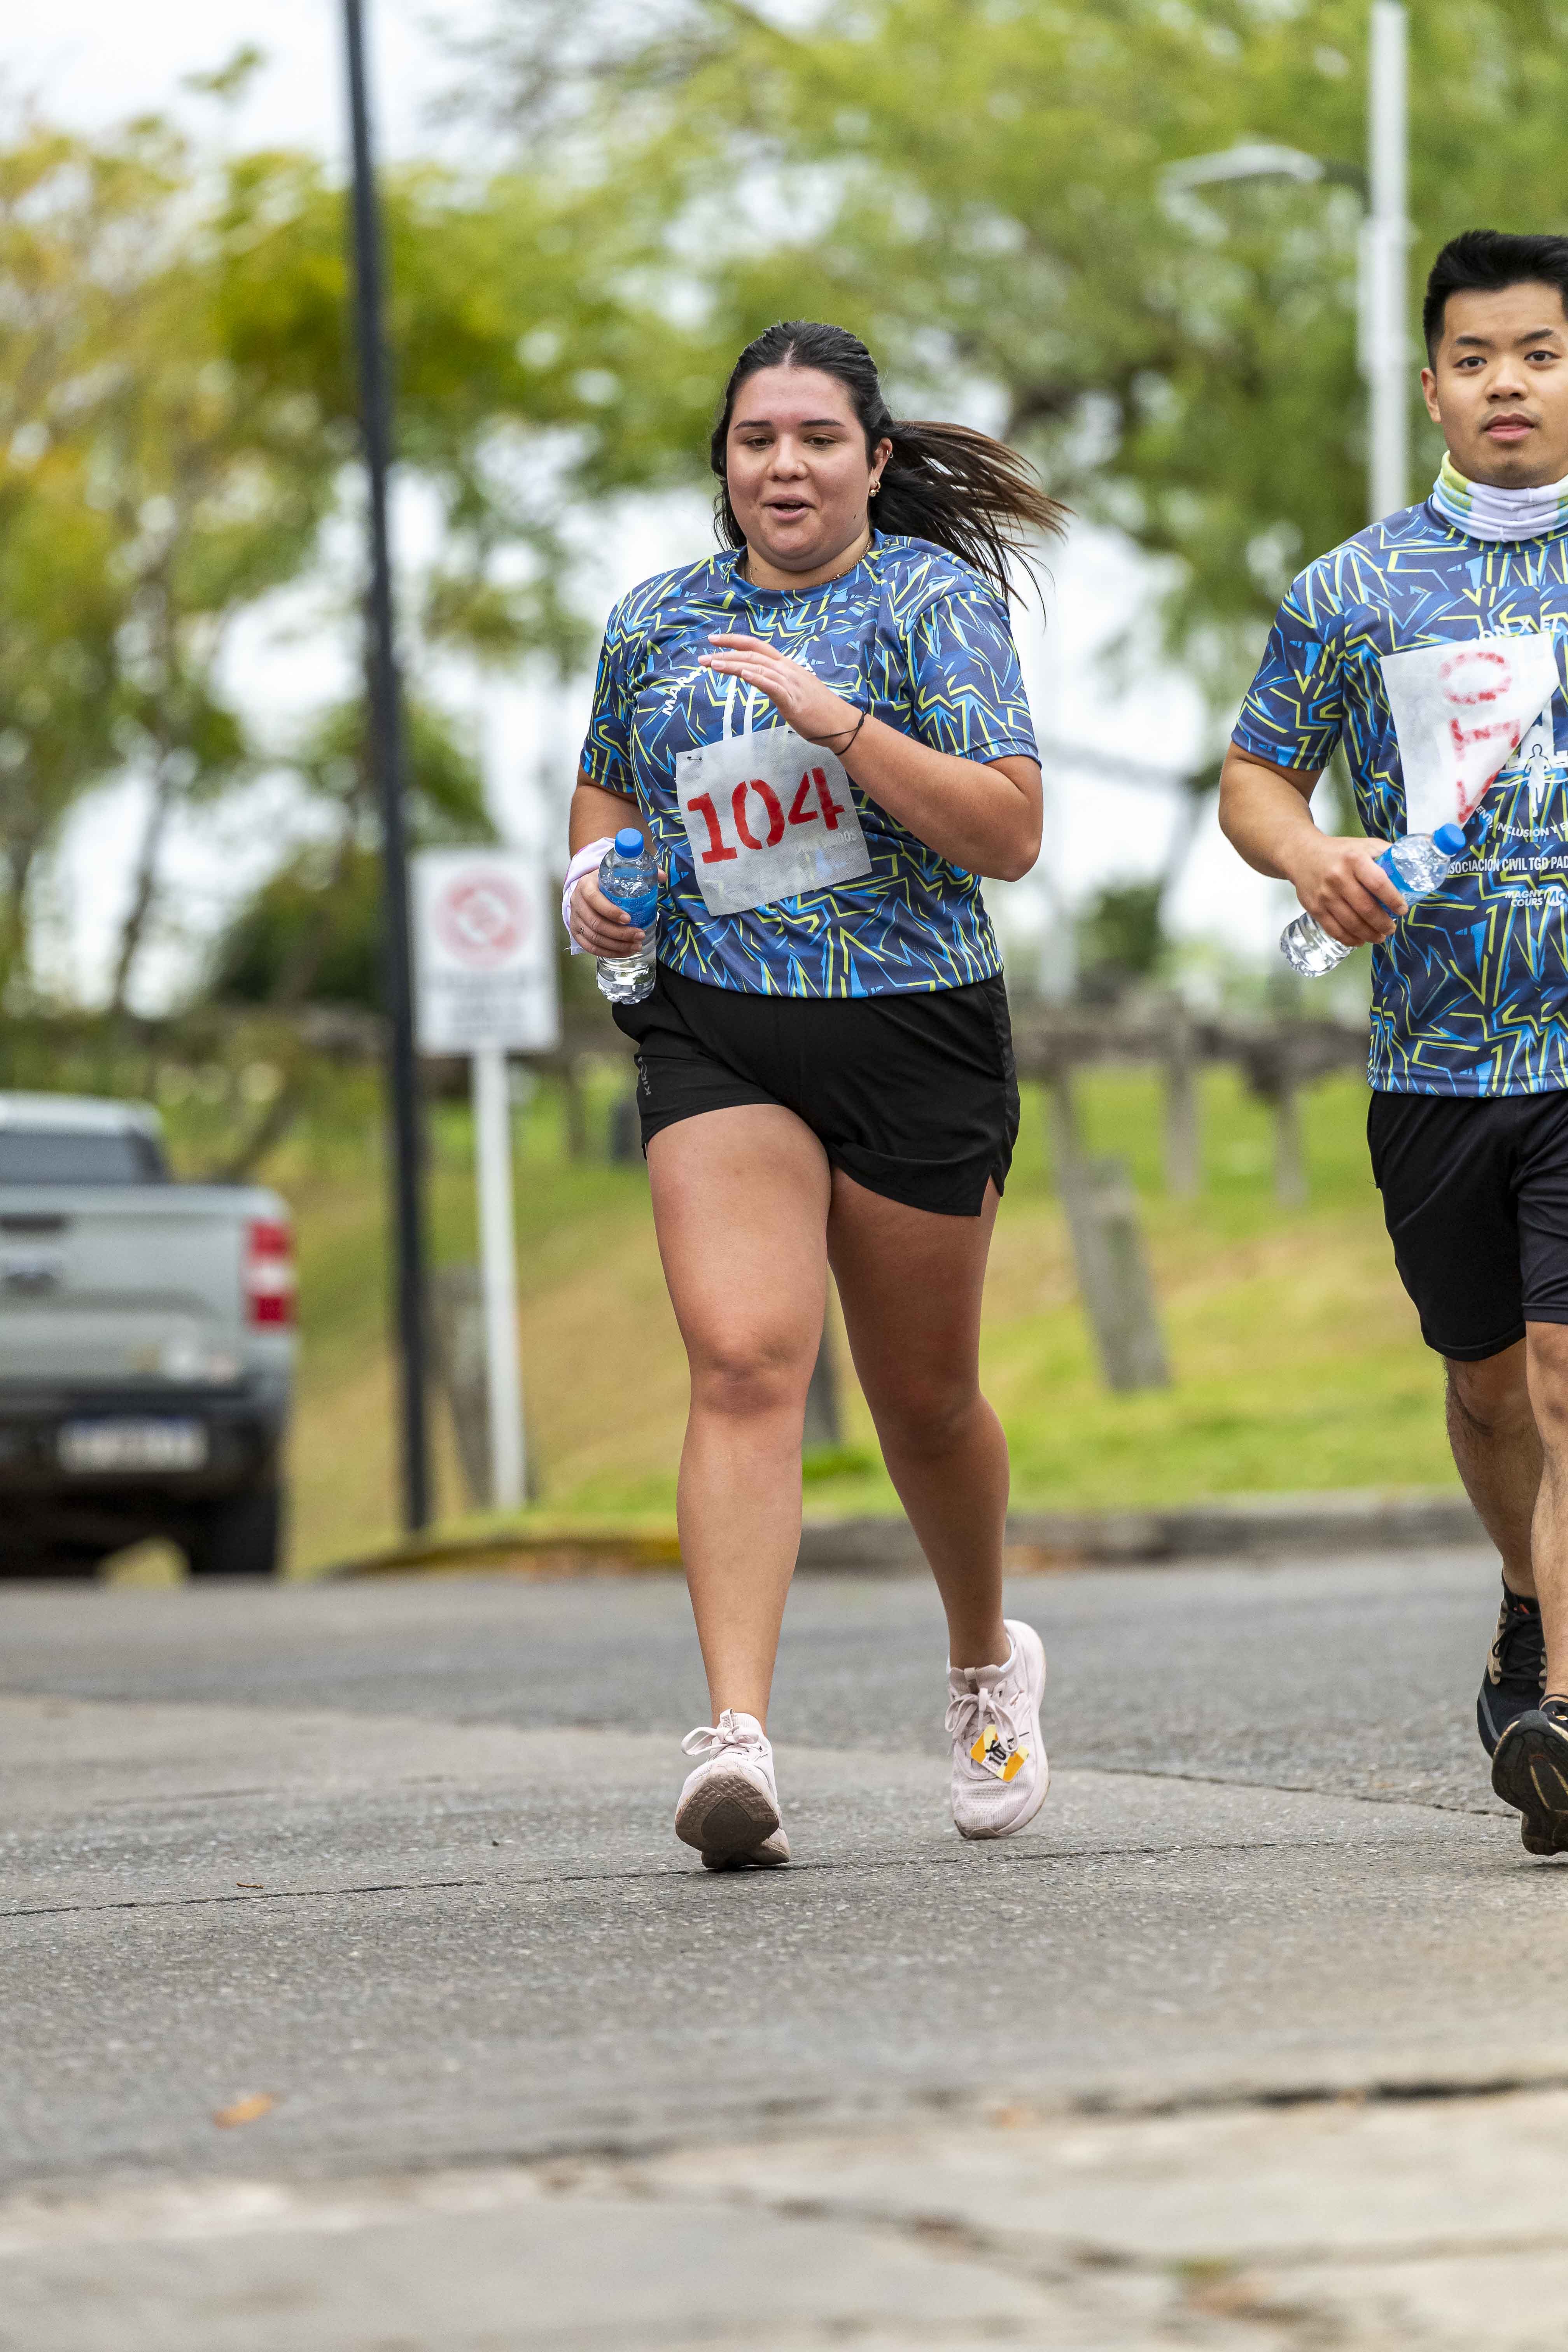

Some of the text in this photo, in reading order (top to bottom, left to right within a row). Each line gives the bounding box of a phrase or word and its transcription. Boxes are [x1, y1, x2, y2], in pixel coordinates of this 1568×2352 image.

[1540, 617, 1561, 633] EL
[687, 767, 845, 864] 104
[1496, 822, 1549, 837] INCLUSIÓN
[1550, 825, 1558, 834] Y
[1502, 858, 1528, 871] CIVIL
[1529, 857, 1548, 870] TGD
[1505, 889, 1543, 899] MAGNY
[1511, 898, 1543, 907] COURS
